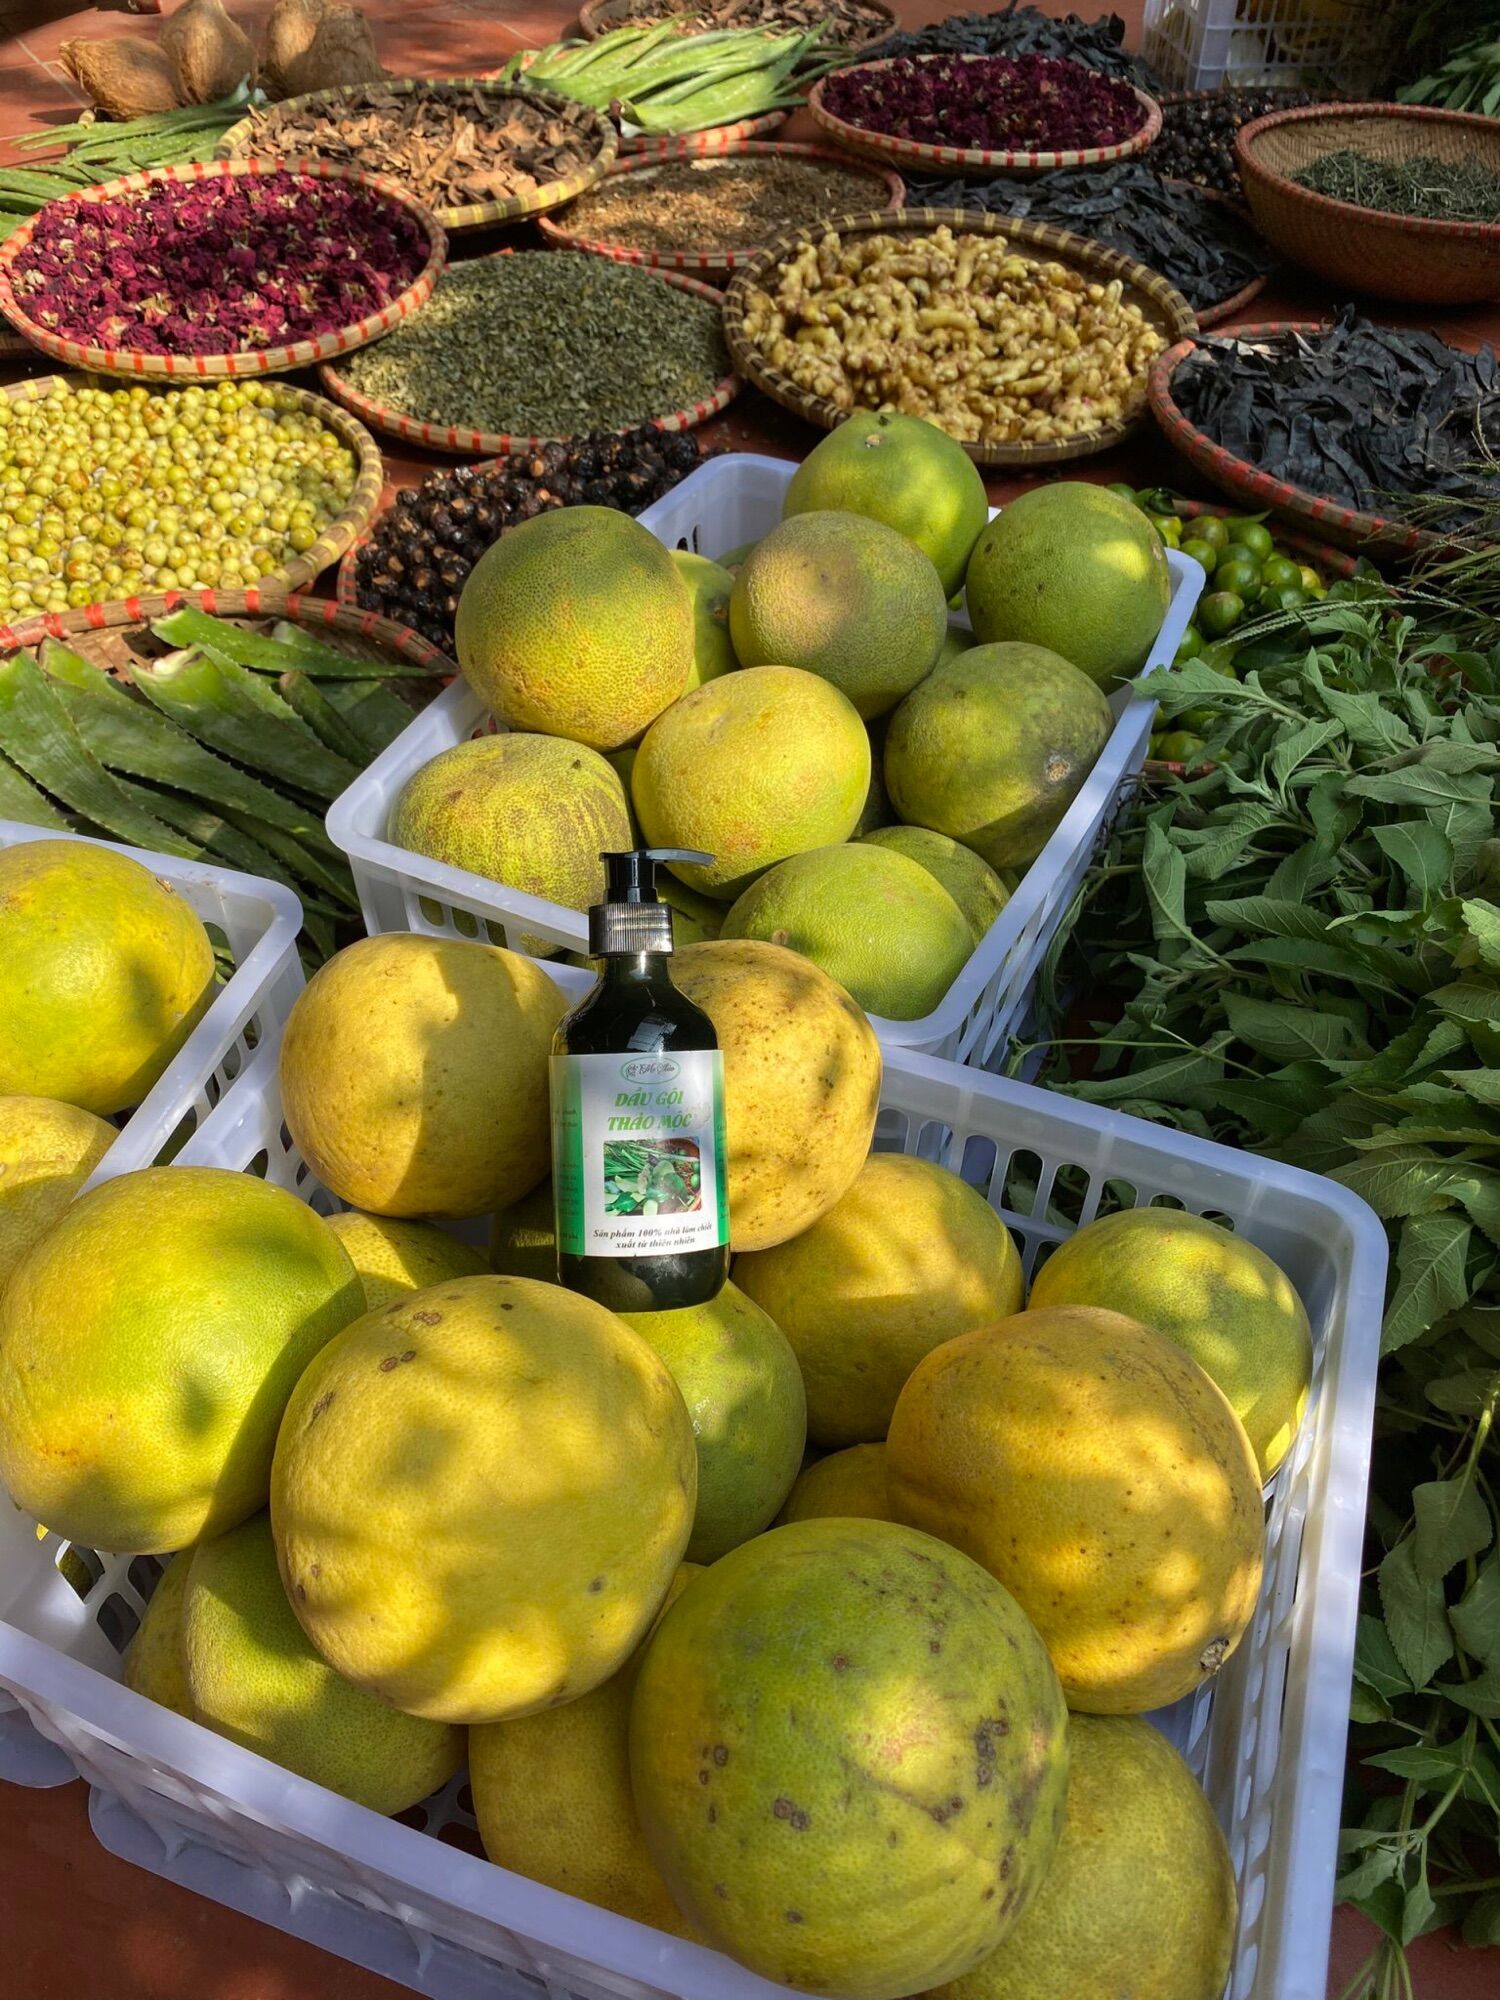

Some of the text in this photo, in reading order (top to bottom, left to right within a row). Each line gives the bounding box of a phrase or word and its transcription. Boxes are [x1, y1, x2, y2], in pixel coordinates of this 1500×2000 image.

[656, 1088, 684, 1109] GỘI
[608, 1111, 692, 1132] THẢO MỘC
[593, 1228, 609, 1238] Sản
[610, 1227, 635, 1239] phẩm
[638, 1228, 662, 1238] 100%
[615, 1238, 636, 1248] xuất
[649, 1238, 672, 1248] thiên
[673, 1236, 696, 1246] nhiên
